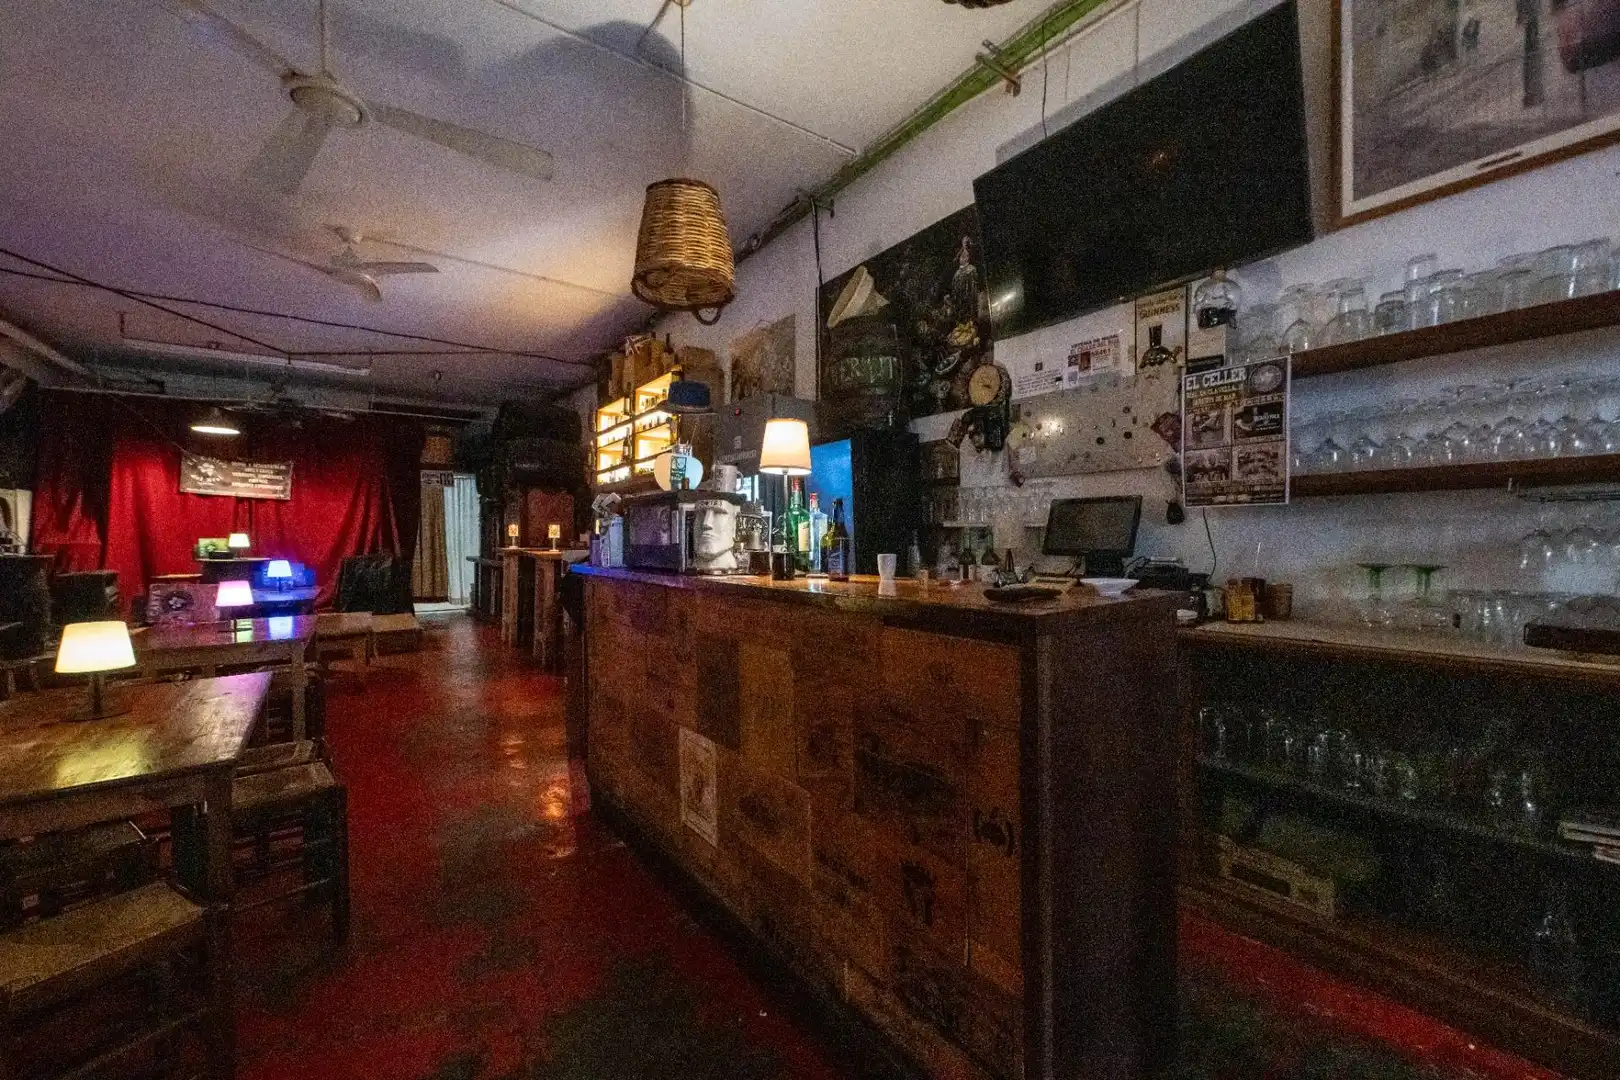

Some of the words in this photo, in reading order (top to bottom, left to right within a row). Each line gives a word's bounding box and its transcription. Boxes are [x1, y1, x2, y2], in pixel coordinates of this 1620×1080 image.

[1139, 303, 1180, 320] GUINNESS
[1186, 376, 1200, 391] EL
[1202, 367, 1247, 388] CELLER
